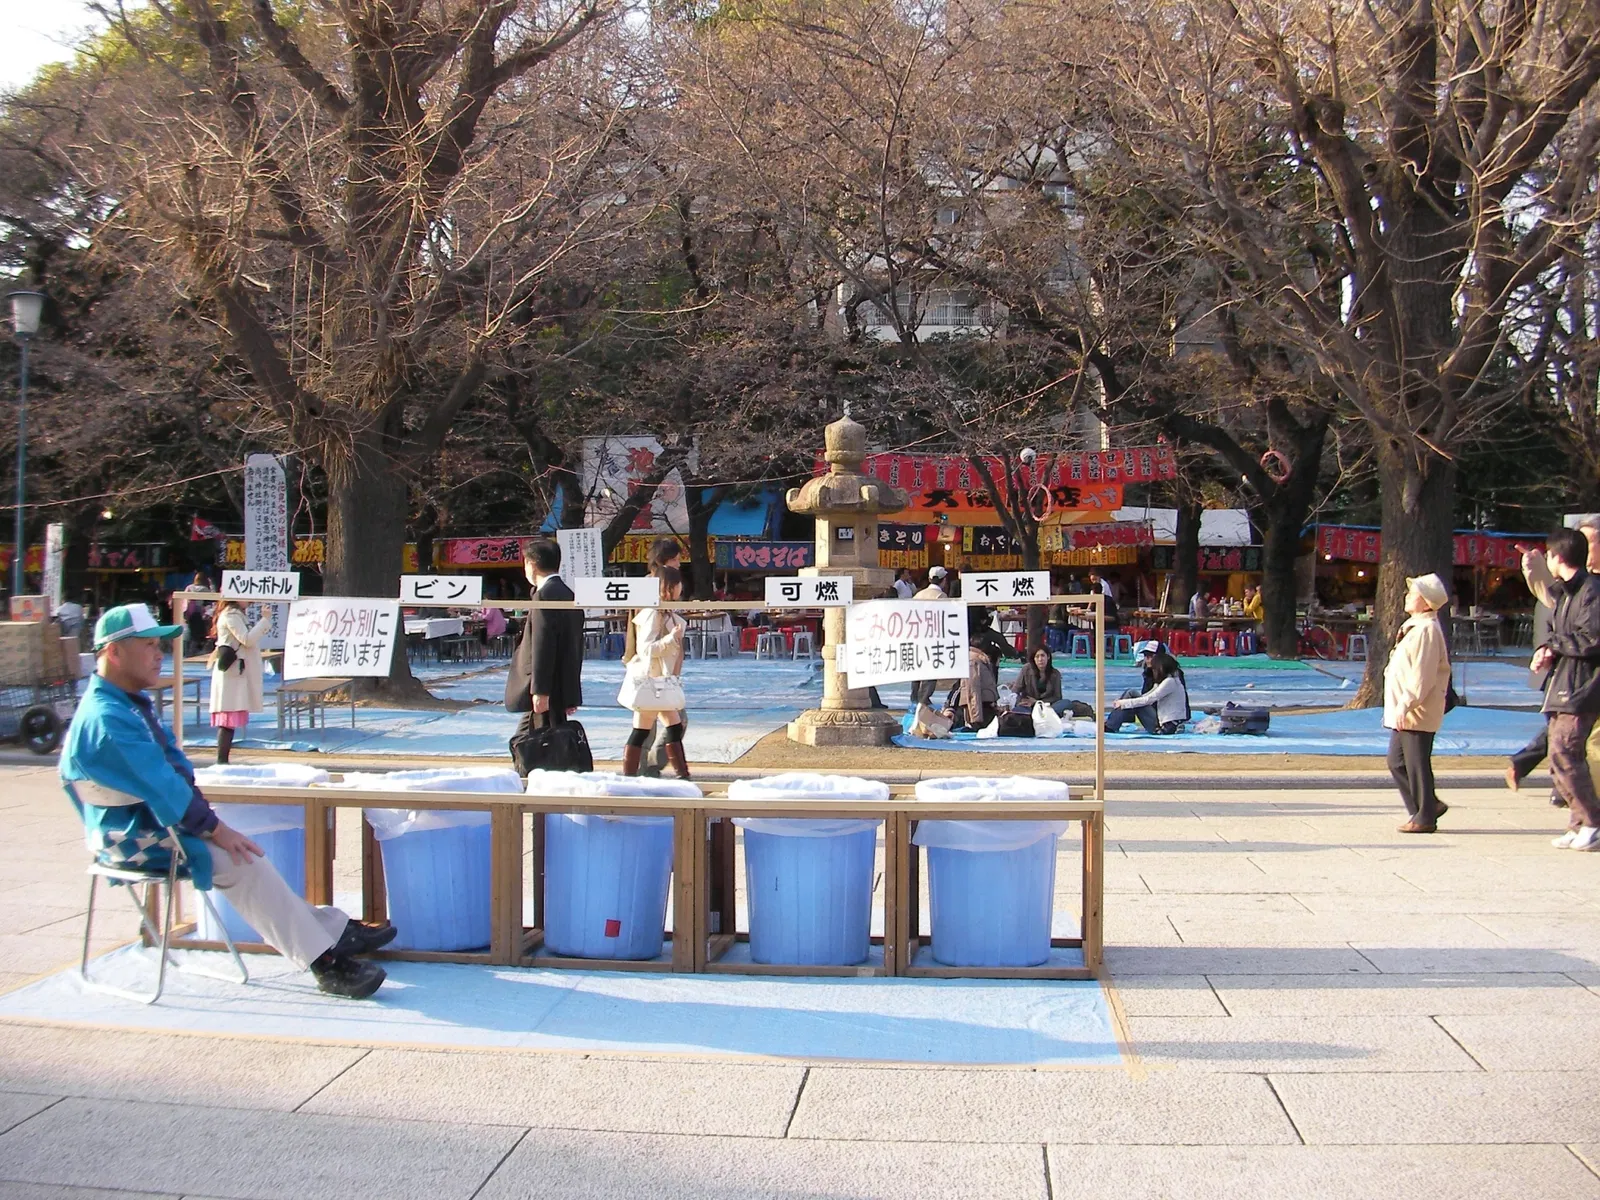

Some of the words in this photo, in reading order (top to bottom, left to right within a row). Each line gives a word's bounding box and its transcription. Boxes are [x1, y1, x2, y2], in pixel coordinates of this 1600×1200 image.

[912, 459, 925, 488] ビール
[277, 482, 287, 572] 花見客の皆様へお
[734, 545, 808, 568] やきそば
[228, 575, 292, 594] ペットボトル
[414, 579, 467, 599] ビン
[604, 581, 630, 601] 缶
[779, 581, 839, 601] 可燃
[975, 577, 1035, 597] 不燃
[294, 608, 390, 638] ごみの分別に
[854, 609, 960, 641] ごみの分別に
[292, 639, 386, 668] ご協力願います
[855, 640, 961, 674] ご協力願います
